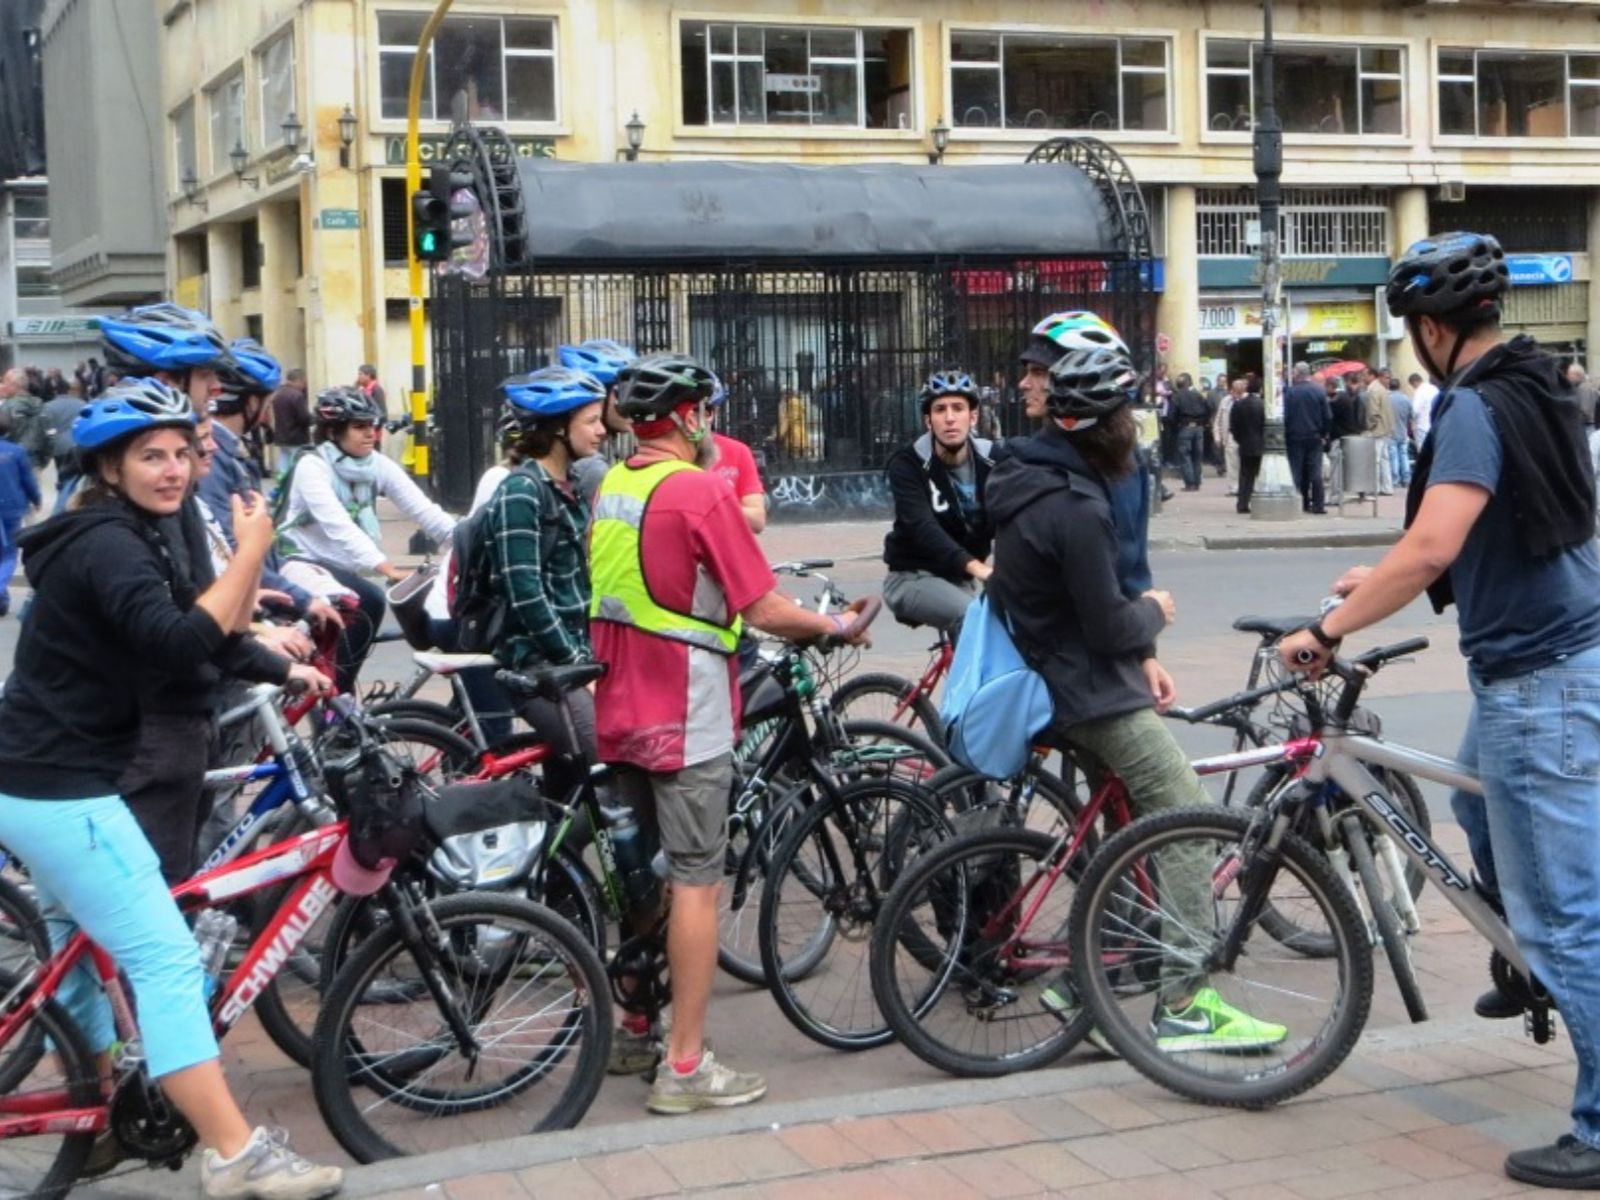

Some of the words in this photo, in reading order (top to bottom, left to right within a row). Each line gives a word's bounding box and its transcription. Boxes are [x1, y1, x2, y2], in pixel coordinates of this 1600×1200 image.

[1252, 261, 1337, 283] SBWAY
[1364, 792, 1468, 890] SCOTT
[218, 875, 339, 1027] SCHWALBE
